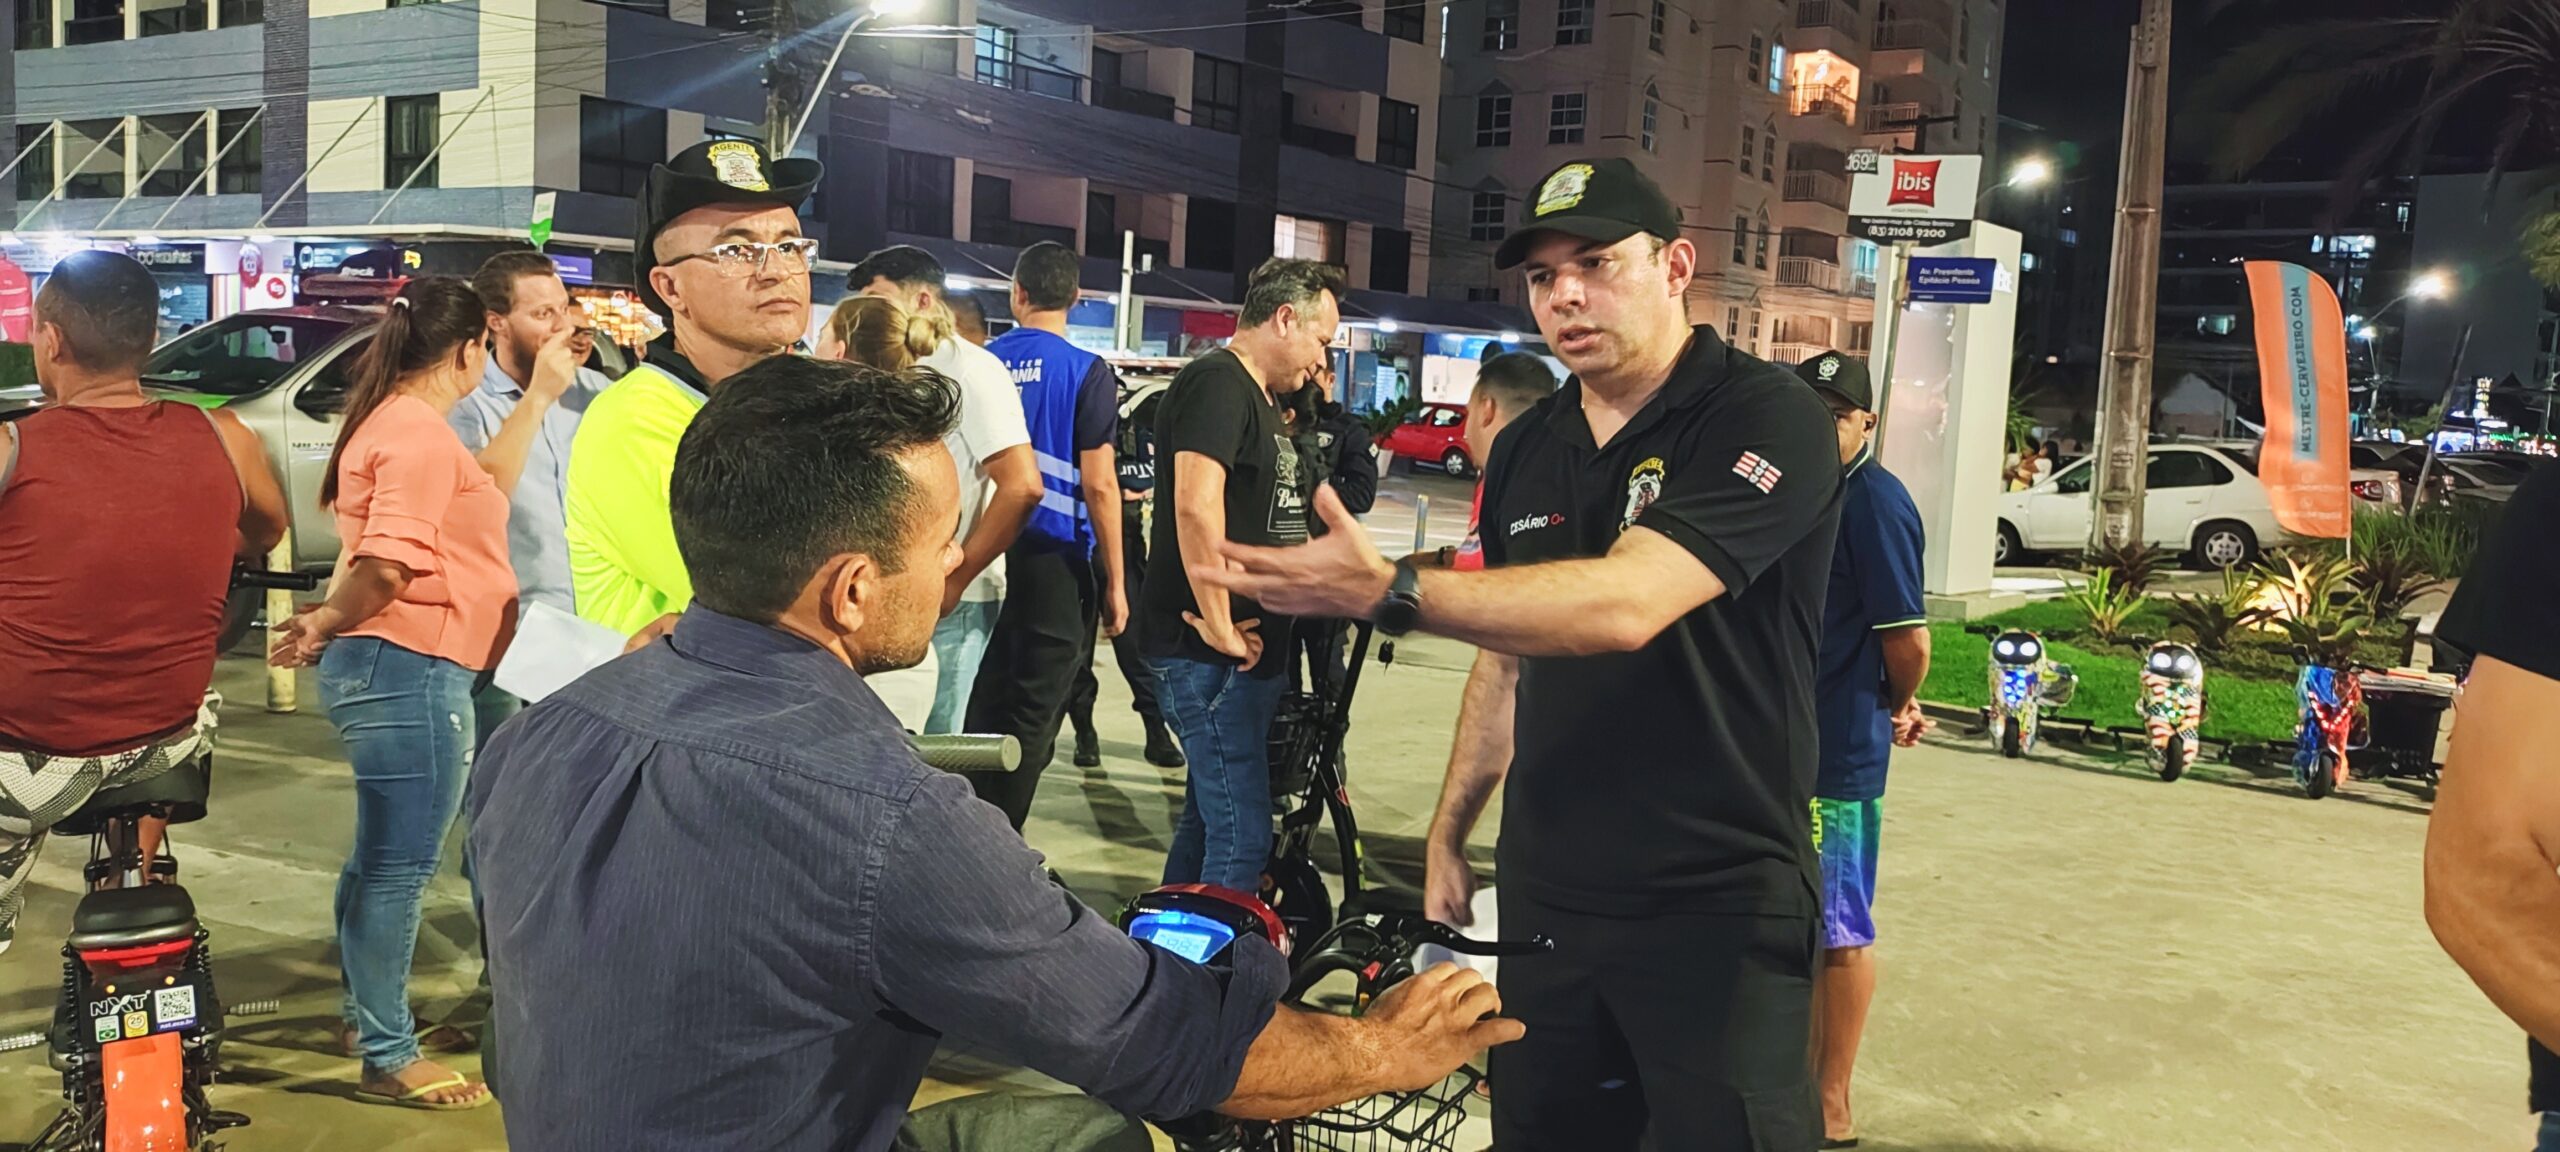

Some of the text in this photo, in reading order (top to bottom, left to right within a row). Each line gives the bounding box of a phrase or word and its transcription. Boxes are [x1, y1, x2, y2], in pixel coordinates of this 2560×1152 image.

[1896, 171, 1931, 191] ibis
[1868, 225, 1946, 238] (83) 2108 9200
[2290, 287, 2312, 453] MESTRE-CERVEJEIRO.COM
[1510, 513, 1548, 535] CESÁRIO
[90, 994, 148, 1017] NXT
